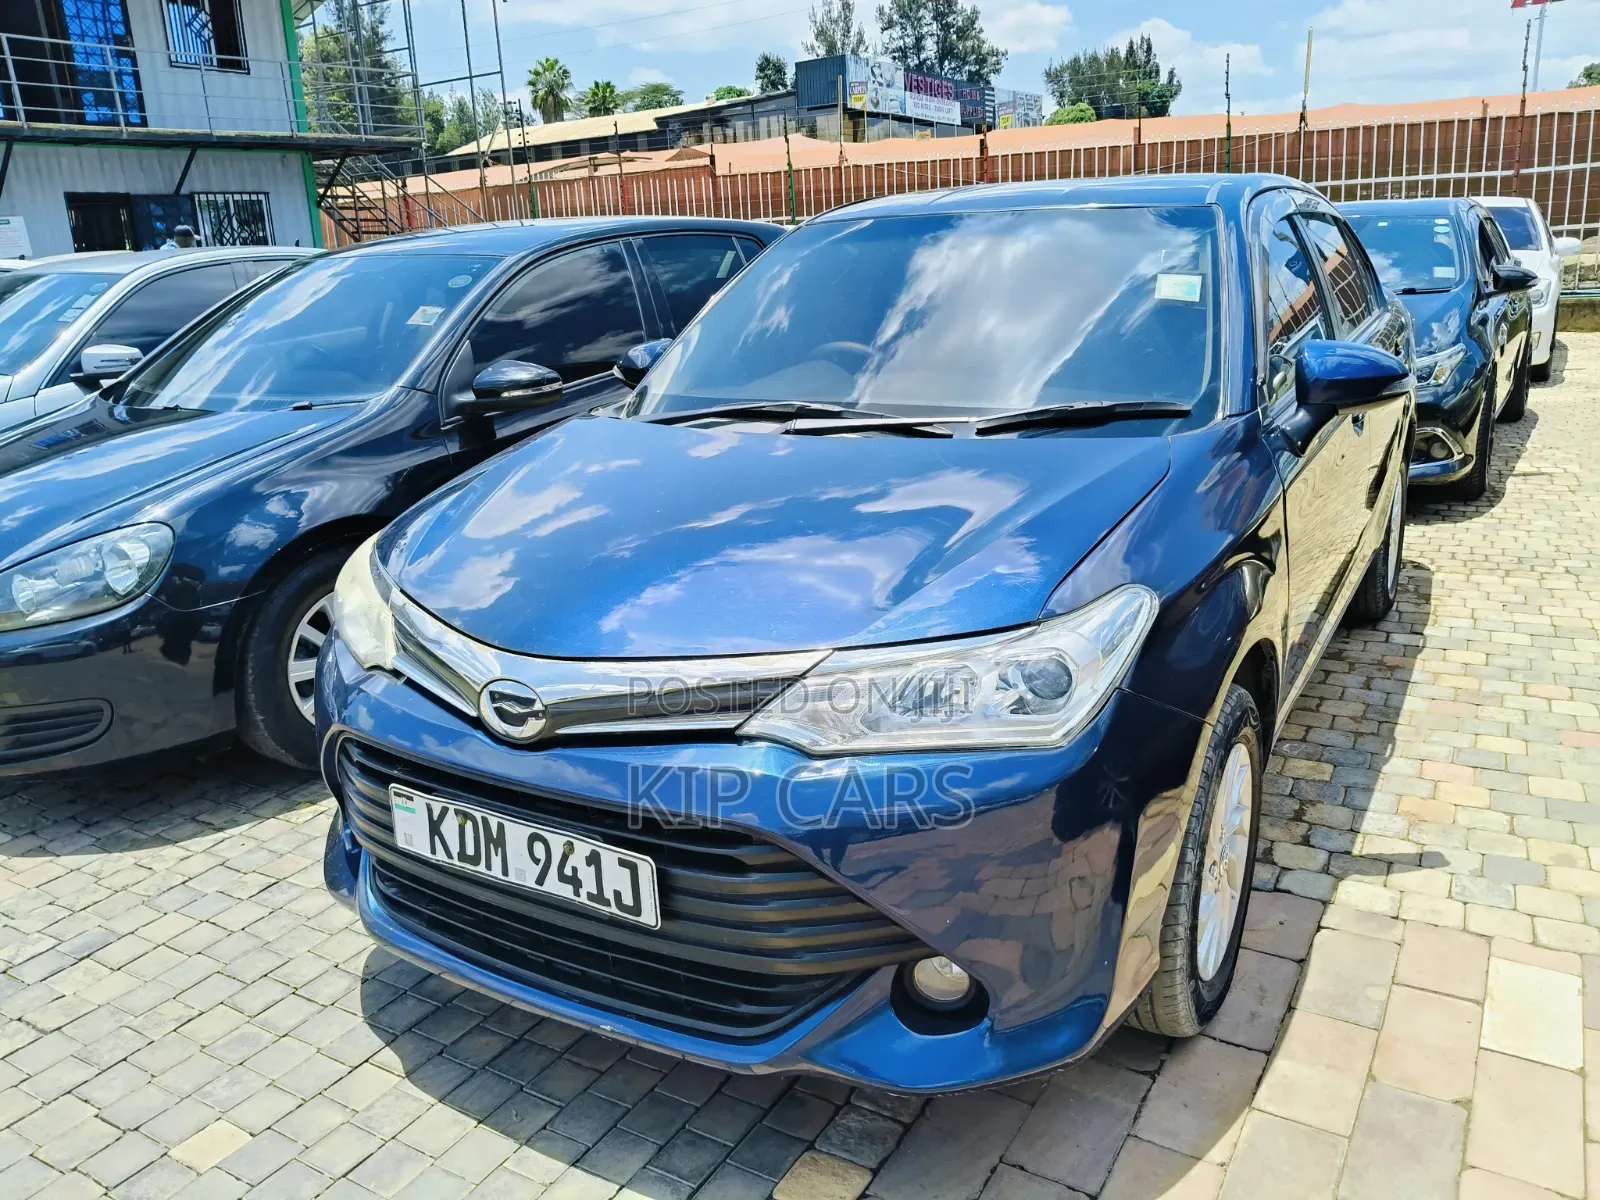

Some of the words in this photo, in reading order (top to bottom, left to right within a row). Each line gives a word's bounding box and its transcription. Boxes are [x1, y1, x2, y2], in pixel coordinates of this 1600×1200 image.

[904, 72, 954, 101] VESTIGES
[963, 88, 980, 100] HOME
[425, 802, 509, 878] KDM
[526, 831, 643, 918] 941J
